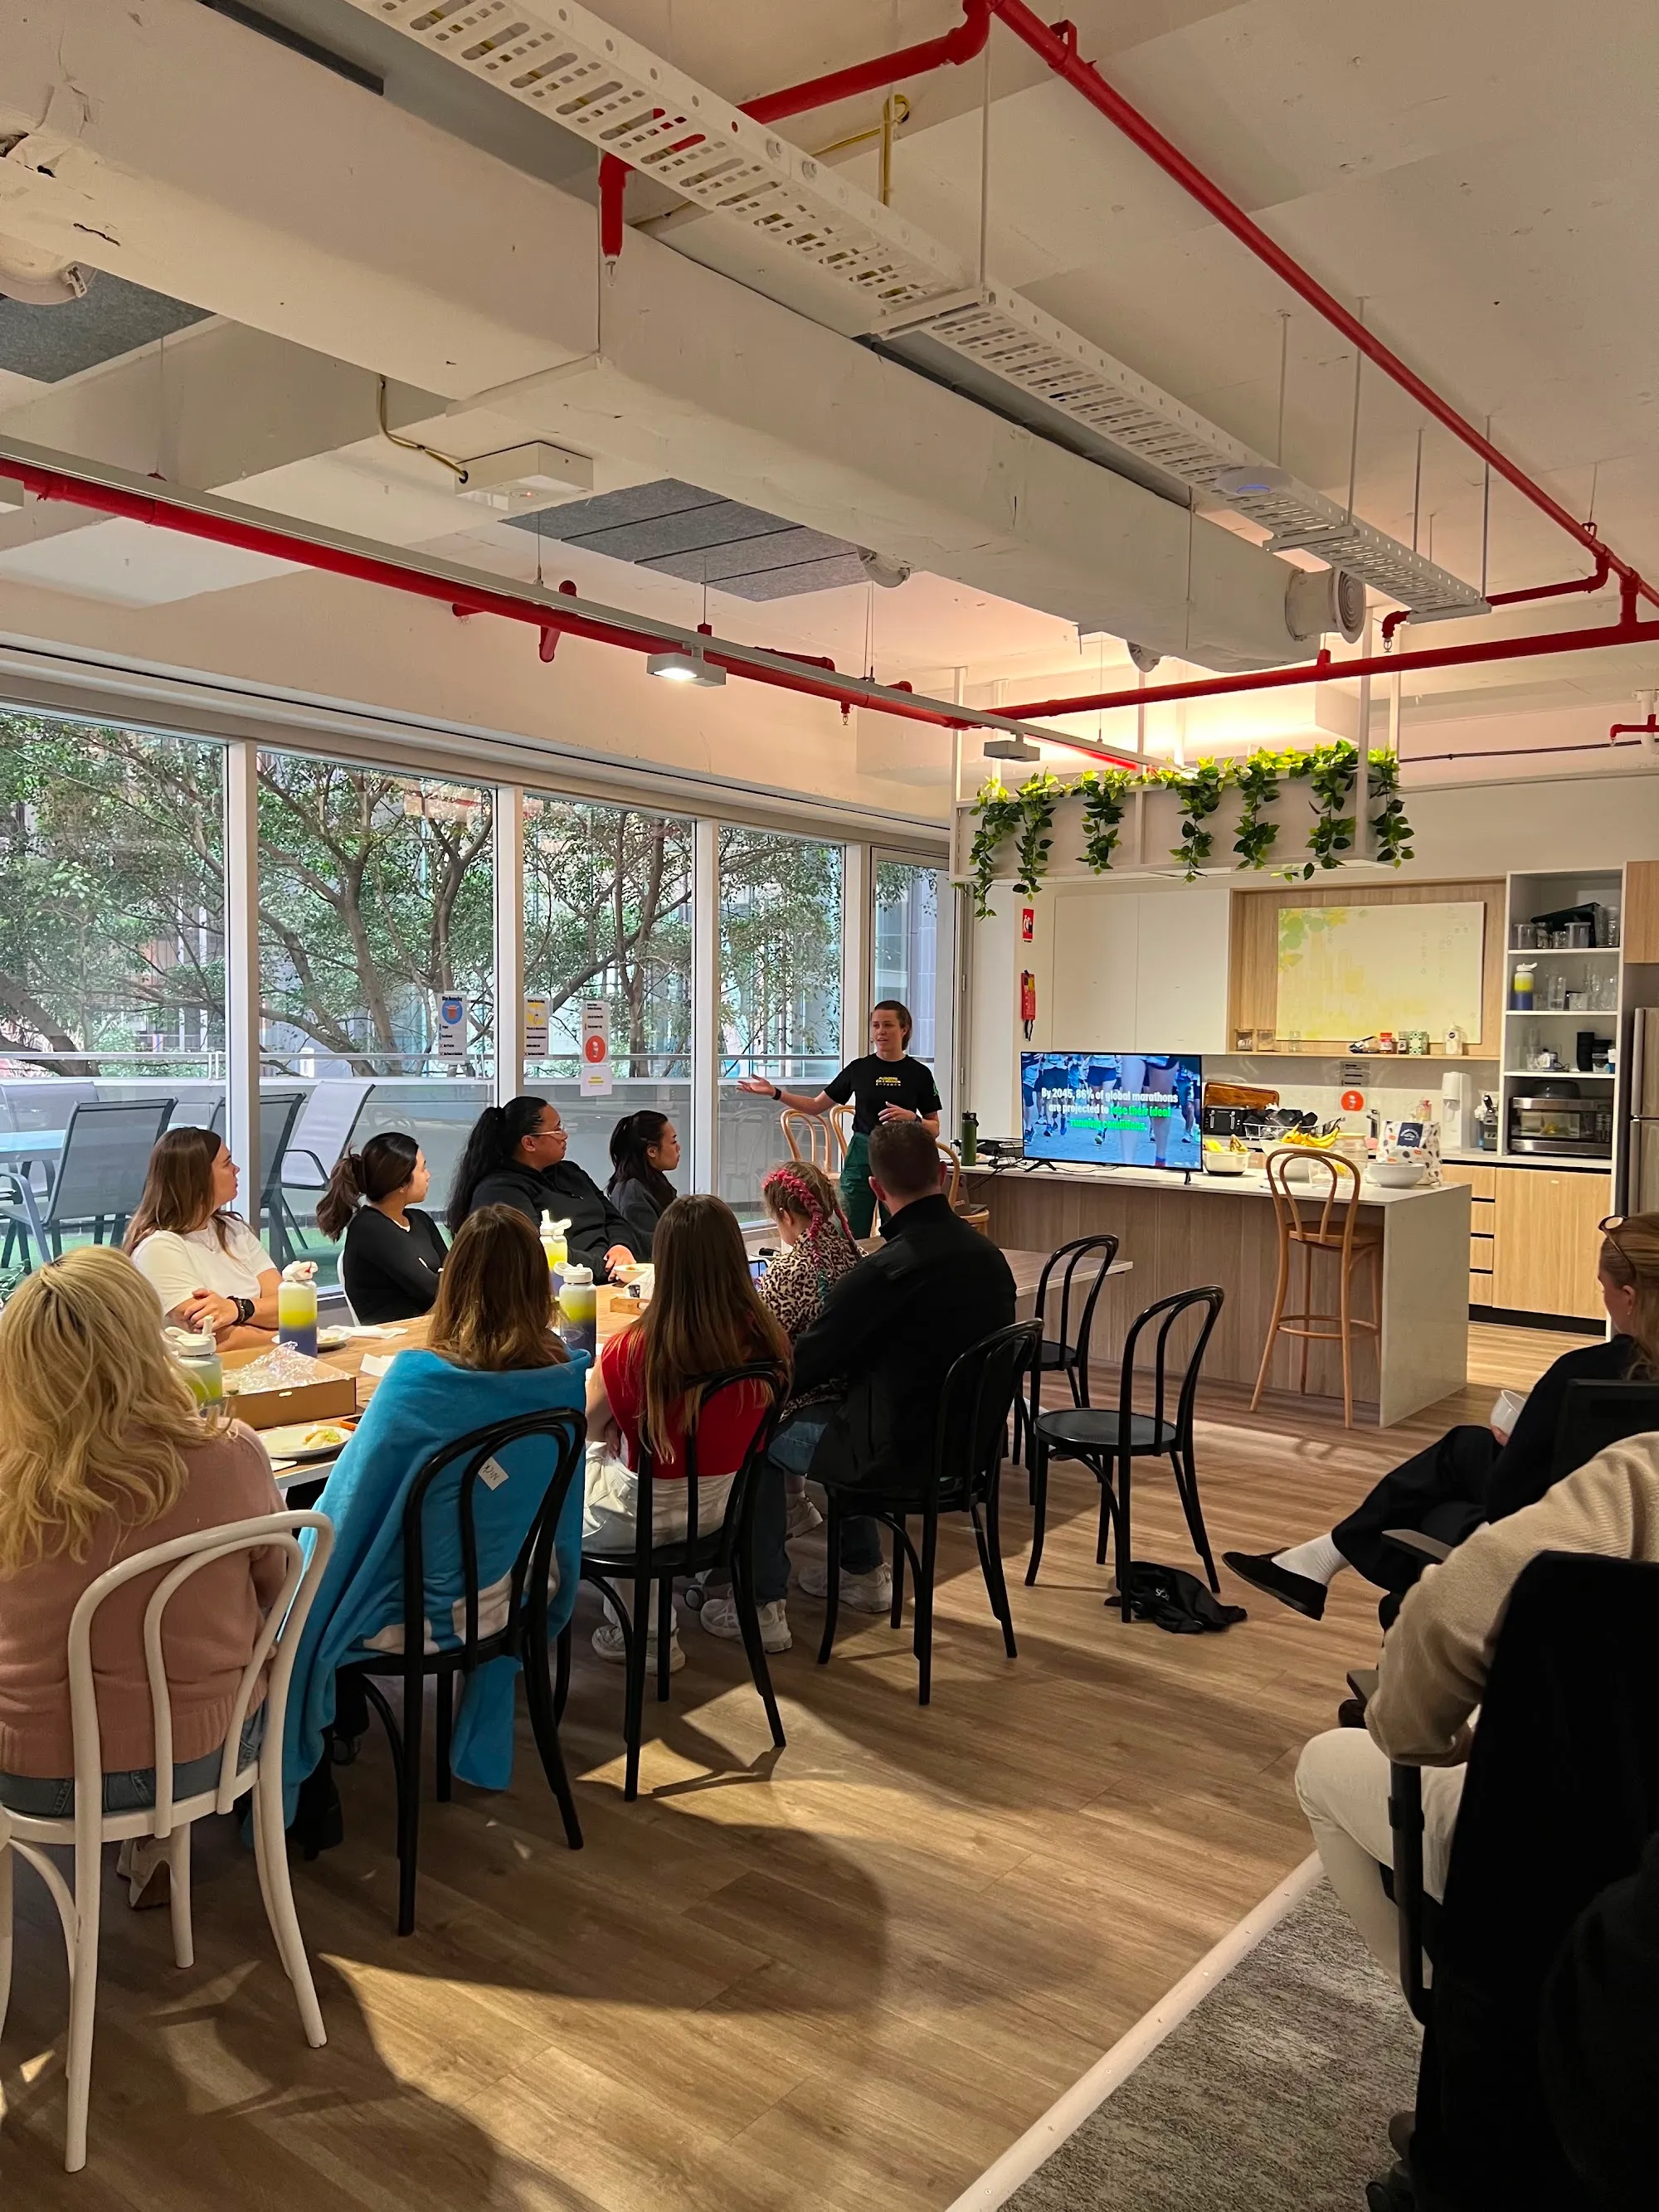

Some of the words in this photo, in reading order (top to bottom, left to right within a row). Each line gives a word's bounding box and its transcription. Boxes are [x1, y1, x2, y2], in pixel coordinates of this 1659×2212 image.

[1041, 1087, 1051, 1099] By
[1052, 1087, 1075, 1101] 2045,
[1075, 1089, 1094, 1100] 86%
[1095, 1089, 1104, 1100] of
[1105, 1090, 1131, 1102] global
[1131, 1092, 1178, 1103] marathons
[1048, 1104, 1062, 1112] are
[1063, 1102, 1100, 1115] projected
[1100, 1105, 1109, 1115] to
[1110, 1104, 1128, 1115] lose
[1128, 1106, 1148, 1116] their
[1149, 1106, 1171, 1117] ideal
[1071, 1118, 1102, 1130] running
